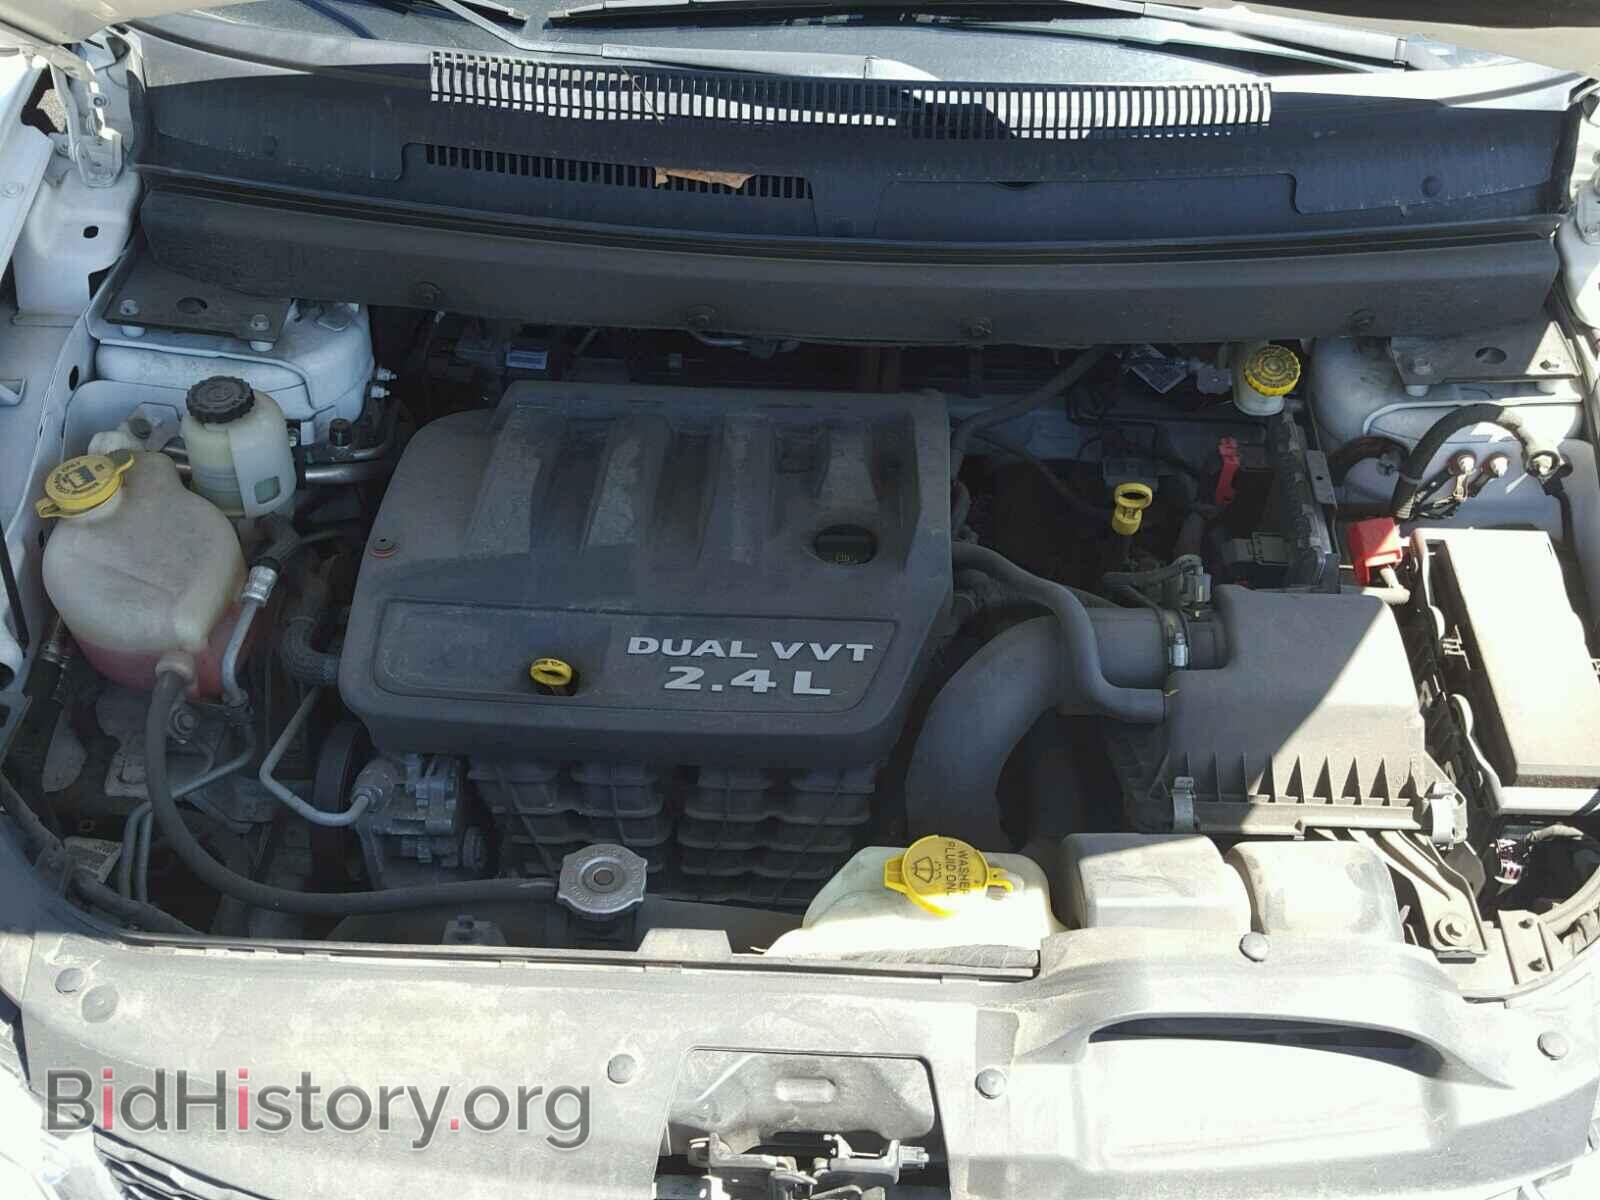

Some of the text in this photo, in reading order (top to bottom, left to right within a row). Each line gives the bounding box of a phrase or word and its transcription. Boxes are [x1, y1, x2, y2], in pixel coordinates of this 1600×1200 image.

[627, 636, 873, 662] DUAL VVT
[945, 841, 957, 897] FLUID ONL
